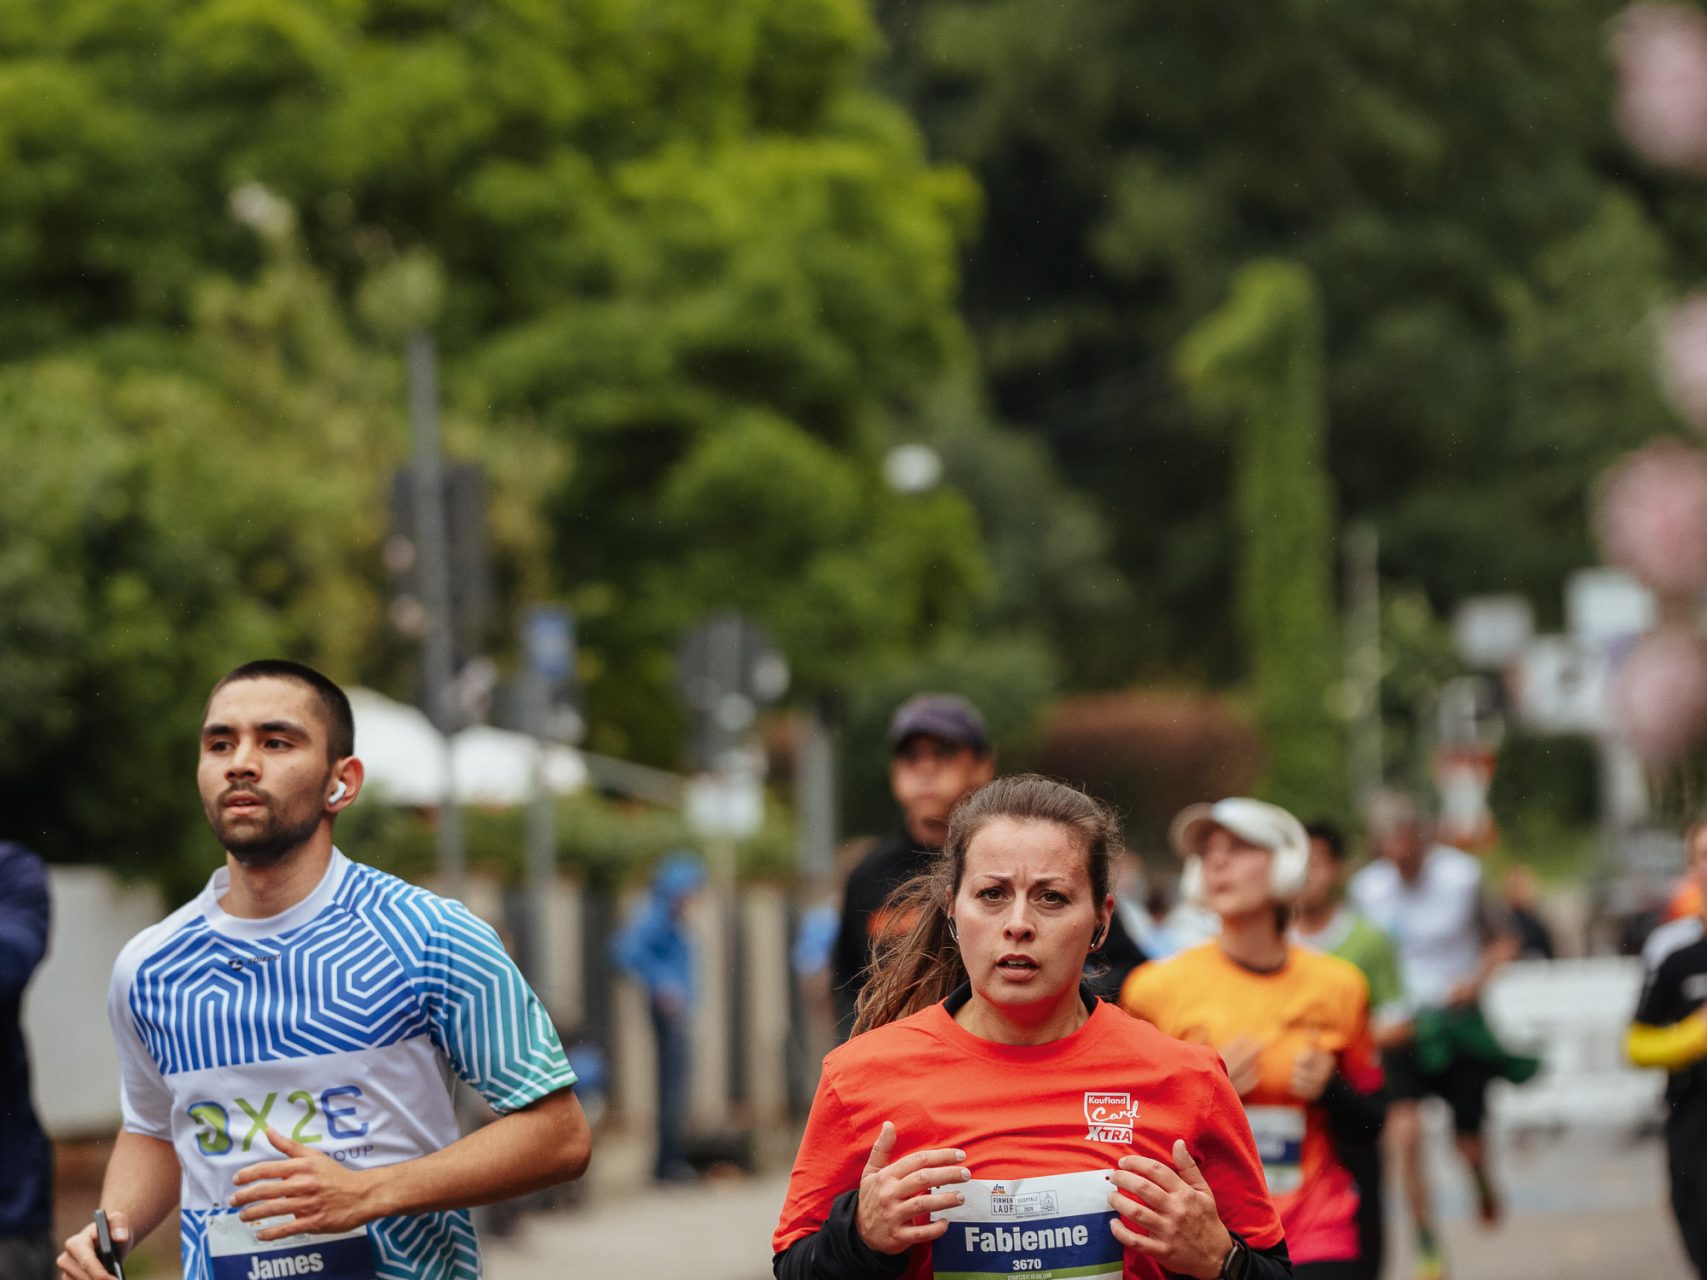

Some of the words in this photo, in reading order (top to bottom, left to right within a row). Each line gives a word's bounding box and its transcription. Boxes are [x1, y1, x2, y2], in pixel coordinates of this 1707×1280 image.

[1088, 1096, 1126, 1104] Kaufland
[1092, 1100, 1141, 1122] Card
[1085, 1126, 1132, 1143] XTRA
[993, 1204, 1014, 1214] LAUF
[964, 1224, 1089, 1253] Fabienne
[247, 1253, 324, 1280] James
[1012, 1258, 1042, 1271] 3670
